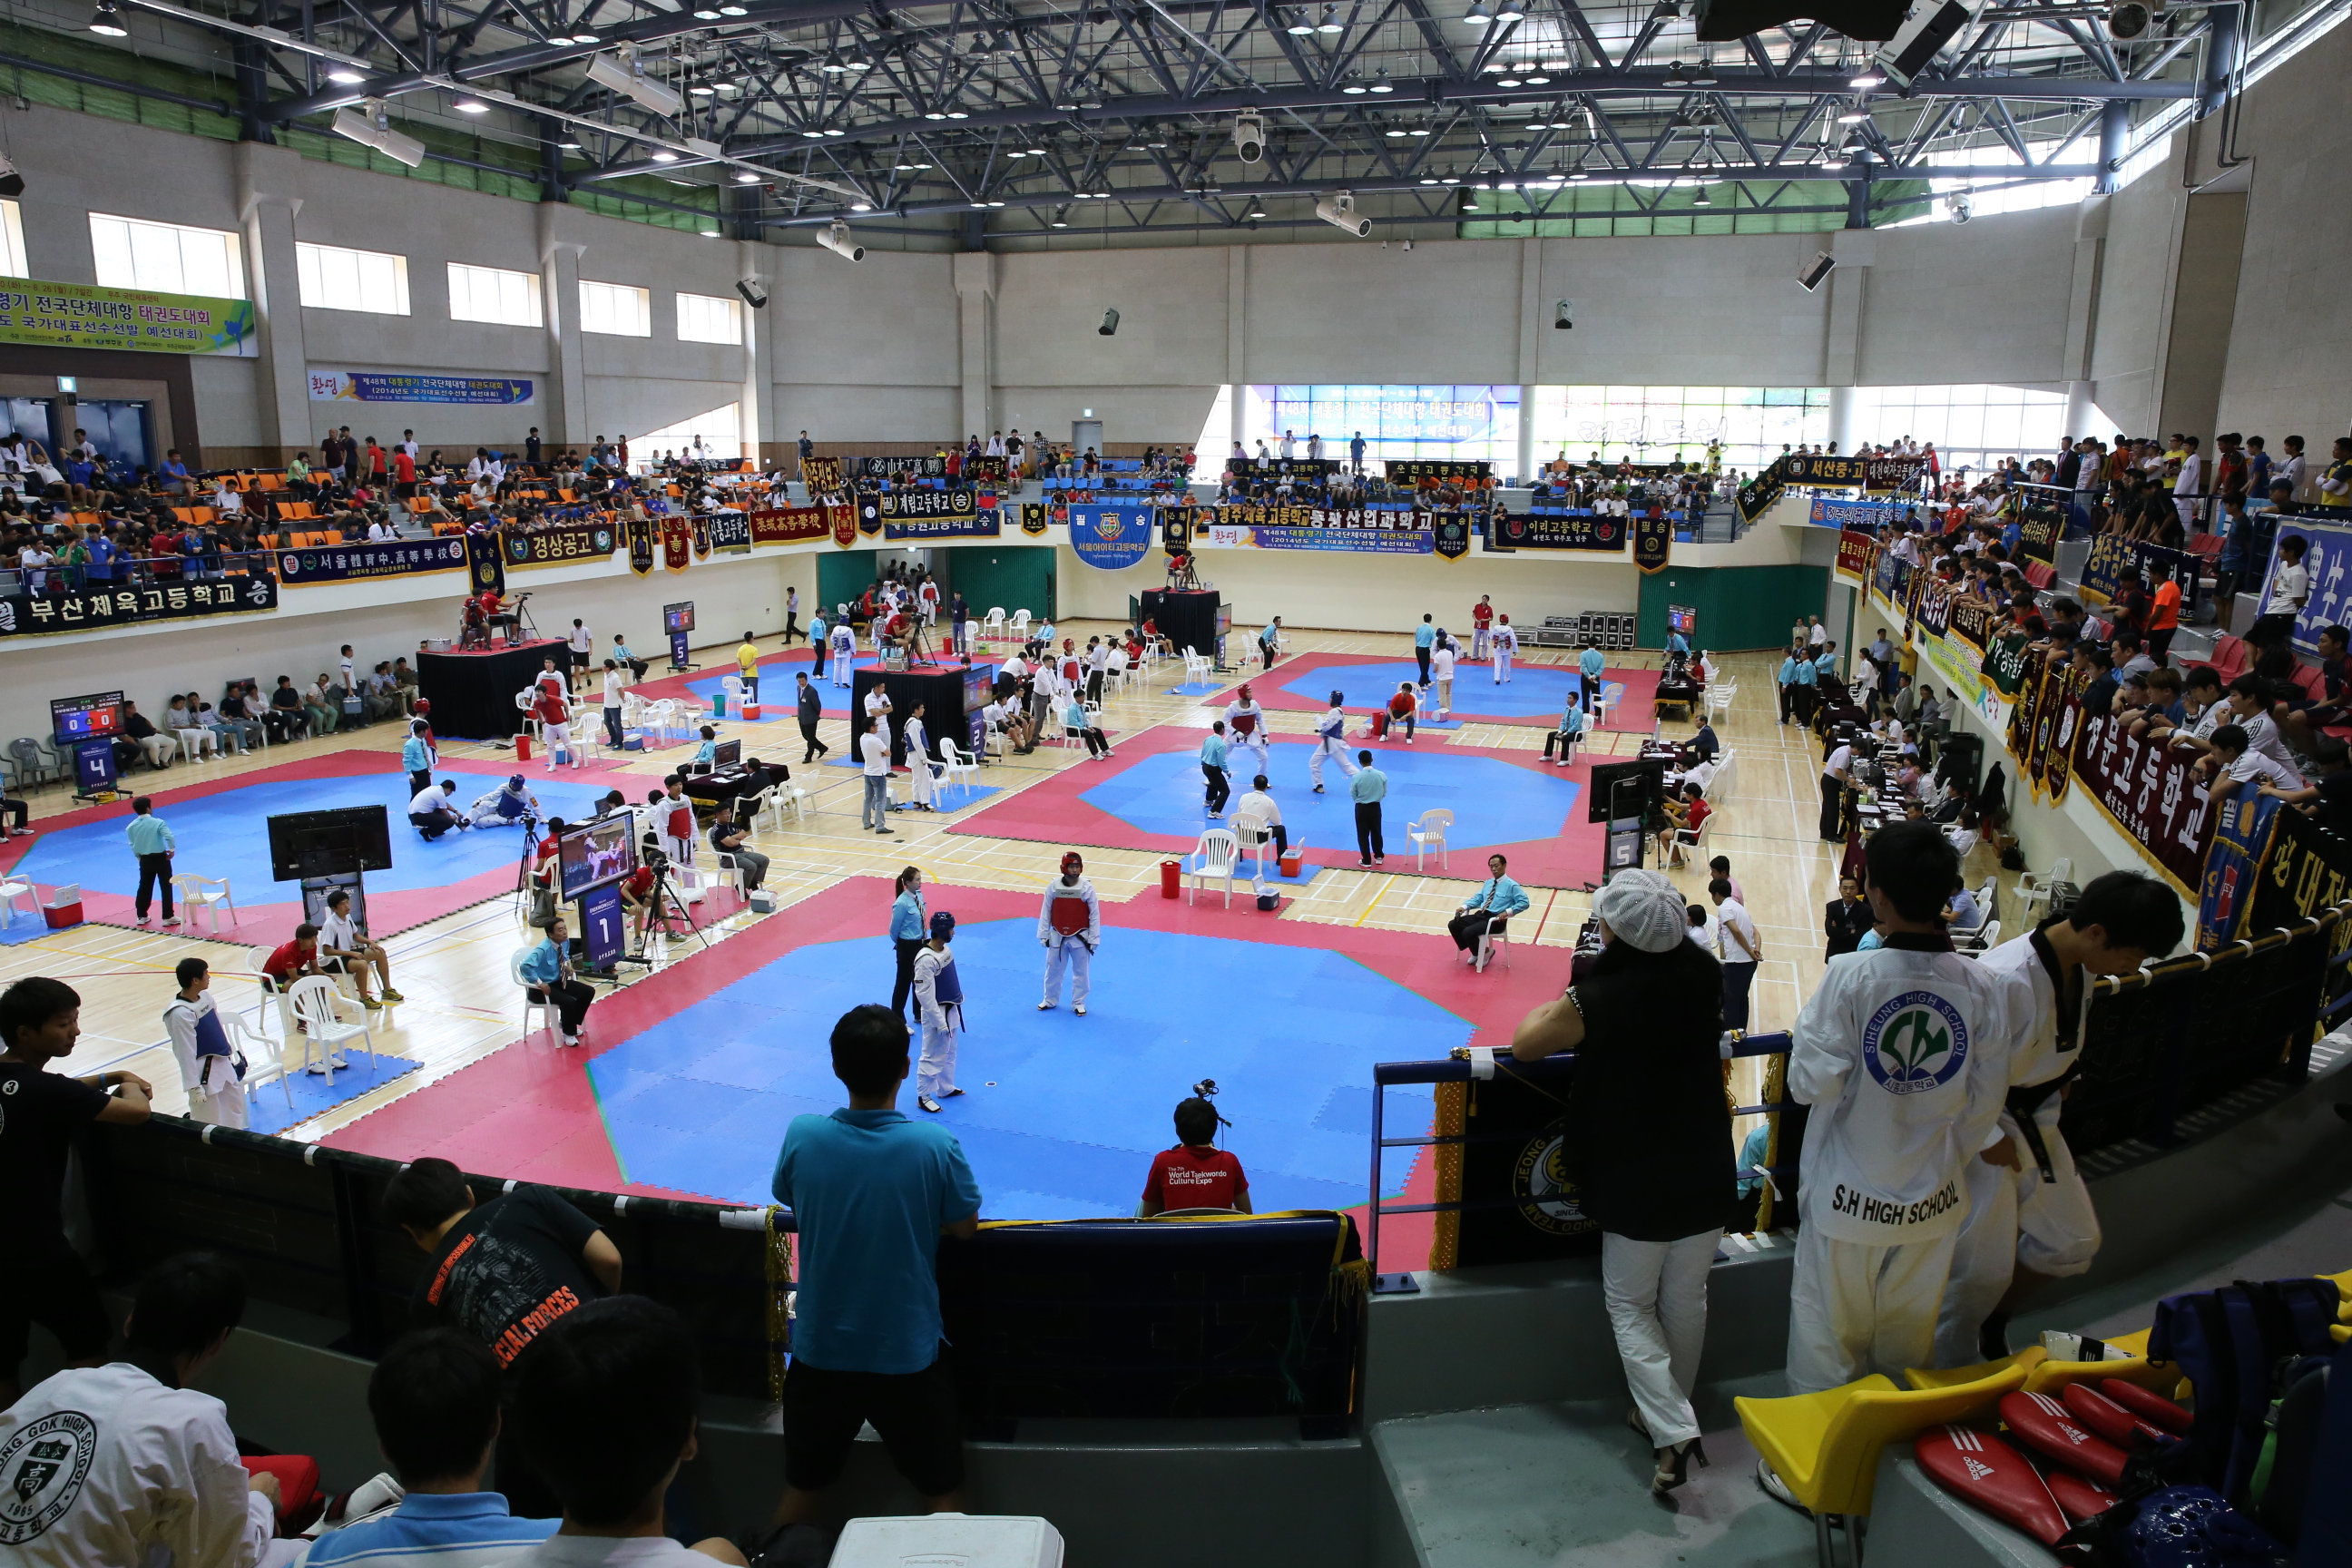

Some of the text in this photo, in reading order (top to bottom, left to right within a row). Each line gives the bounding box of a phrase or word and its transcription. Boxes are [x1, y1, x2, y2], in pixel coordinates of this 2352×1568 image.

[35, 296, 132, 320] 전국단체대항
[139, 305, 211, 326] 태권도대회
[22, 316, 139, 337] 국가대표선수선발
[147, 326, 203, 341] 예선대회)
[311, 376, 338, 395] 환영
[388, 377, 419, 387] 대통령기
[422, 378, 466, 388] 전국단체대항
[468, 381, 503, 389] 태권도대회
[413, 388, 467, 397] 국가대표선수선발
[1277, 402, 1486, 420] 제48회 대통령기 전국단체대항 태권도대회
[1426, 424, 1472, 437] 예선대회)
[1577, 415, 1729, 452] 태권도원
[900, 493, 949, 514] 계림고등학교
[1076, 514, 1145, 526] 필 승
[1529, 521, 1592, 534] 이리고등학교
[1642, 521, 1666, 534] 필 승
[1214, 529, 1238, 544] 환영
[1289, 529, 1322, 537] 대통령기
[1326, 531, 1377, 540] 전국단체대항
[1379, 532, 1422, 541] 태권도대회
[1313, 538, 1376, 546] 국가대표선수선발
[533, 532, 592, 559] 경상공고
[1077, 543, 1145, 552] 서울아이티고등학교
[30, 583, 236, 622] 부산체육고등학교
[677, 646, 684, 659] 5
[69, 720, 78, 730] 0
[101, 714, 109, 726] 0
[974, 729, 980, 747] 2
[90, 759, 106, 777] 4
[599, 917, 609, 944] 1
[1865, 993, 1965, 1057] SIHEUNG HIGH SCHOOL
[6, 1082, 15, 1093] 3
[1885, 1077, 1936, 1092] 시흥고등학교
[1518, 1139, 1546, 1183] JEONG
[1169, 1170, 1227, 1179] World Taekwondo
[1832, 1180, 1959, 1225] S.H HIGH SCHOOL
[427, 1234, 475, 1305] NOTHING IS IMPOSSIBLE
[521, 1286, 580, 1337] FORCES
[28, 1416, 59, 1438] GOK
[62, 1415, 88, 1435] HIGH
[2057, 1422, 2081, 1446] adidas
[68, 1431, 92, 1490] SCHOOL
[1963, 1456, 1981, 1481] adidas
[18, 1464, 46, 1495] 高
[7, 1502, 34, 1517] 1965
